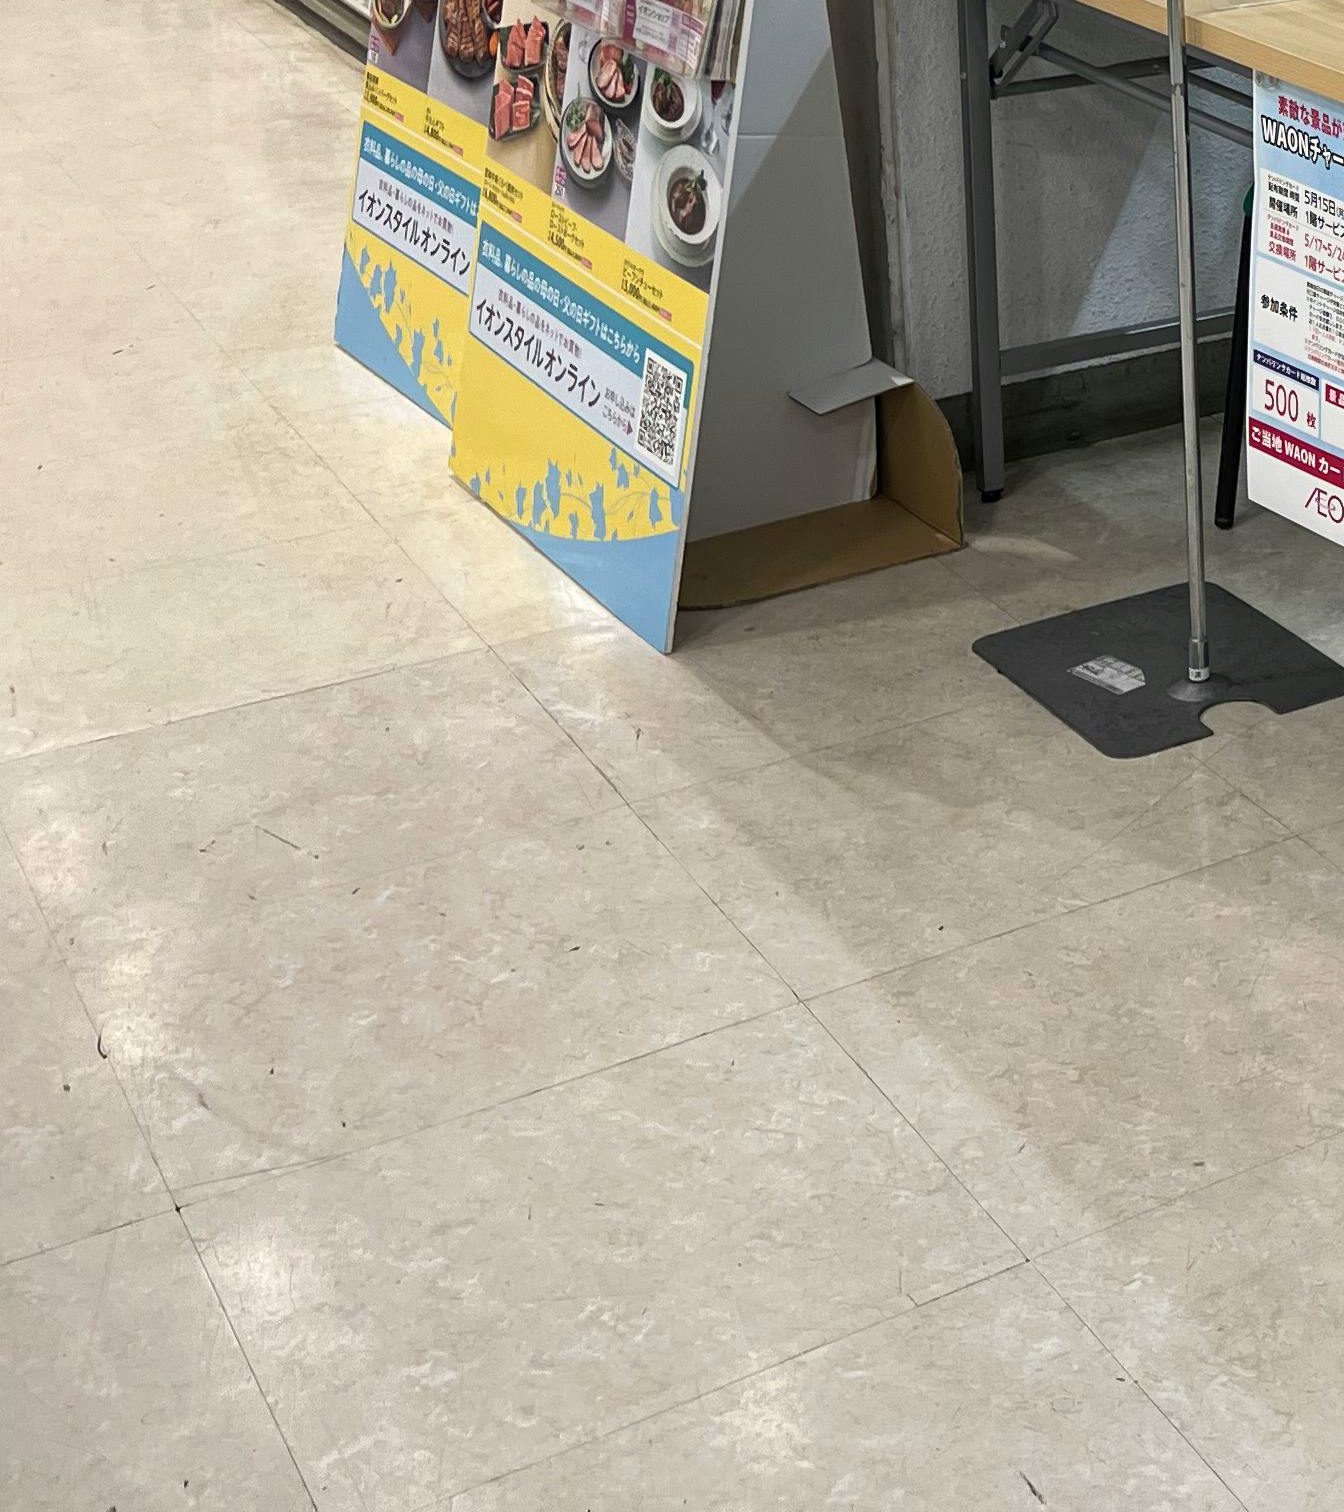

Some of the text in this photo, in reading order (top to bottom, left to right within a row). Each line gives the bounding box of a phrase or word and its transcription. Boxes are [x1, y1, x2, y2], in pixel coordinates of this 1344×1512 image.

[358, 188, 471, 276] イオンスタイルオンライン
[476, 298, 601, 408] イオンスタイルオンライン
[1263, 378, 1300, 422] 500
[1284, 440, 1317, 468] WAON
